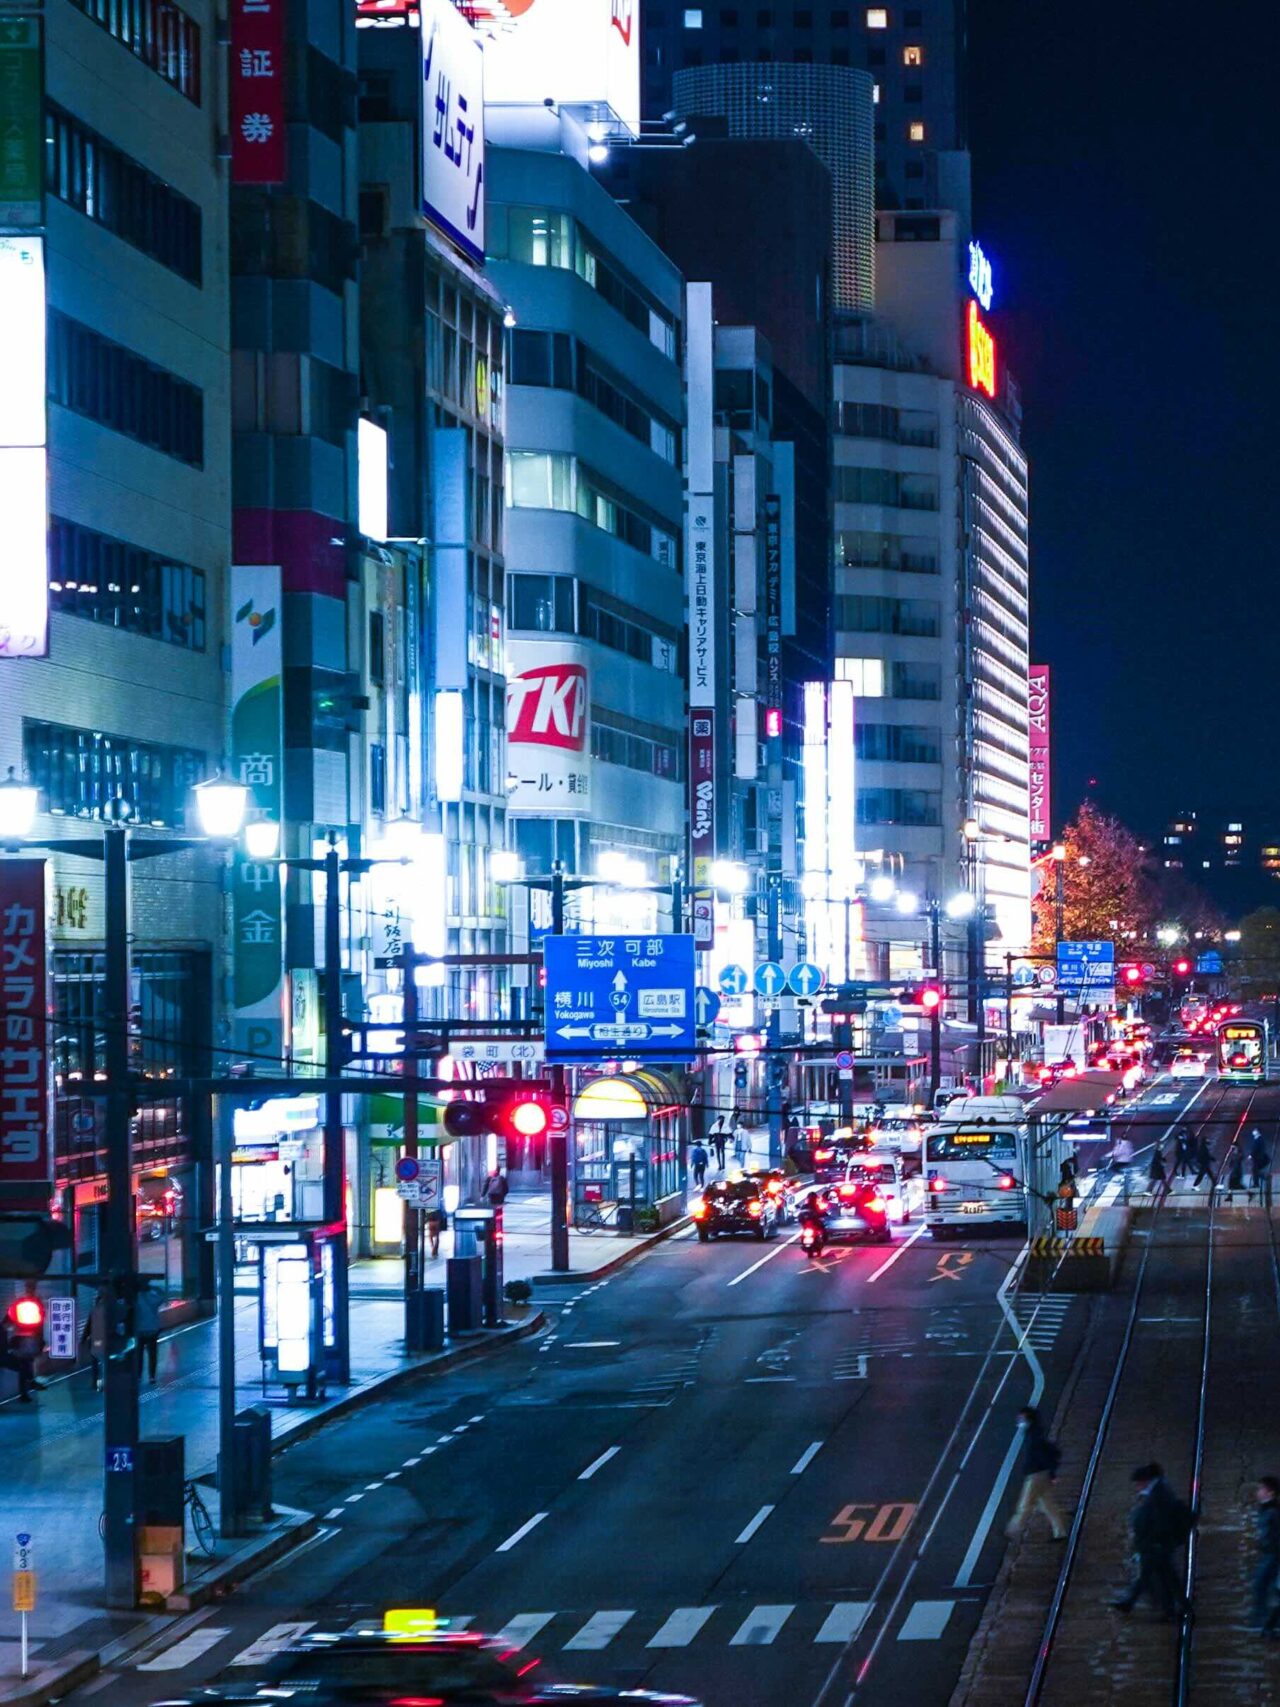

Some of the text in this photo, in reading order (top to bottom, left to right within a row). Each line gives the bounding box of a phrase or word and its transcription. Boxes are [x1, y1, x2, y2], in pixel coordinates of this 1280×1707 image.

[695, 541, 708, 687] 東京海上日動キャリアサービス
[507, 675, 586, 738] TKP
[692, 780, 713, 839] Wants
[1030, 771, 1045, 834] センター街
[239, 752, 275, 943] 商中金
[382, 896, 401, 954] 川飯店
[576, 939, 664, 957] 三次 可部
[578, 958, 656, 969] Miyoshi Kabe
[554, 991, 595, 1008] 横川
[554, 1010, 595, 1020] Yokogawa
[612, 994, 628, 1005] 54
[642, 993, 681, 1005] 広島駅
[1, 903, 43, 1163] カメラのサエダ
[819, 1503, 918, 1543] 50
